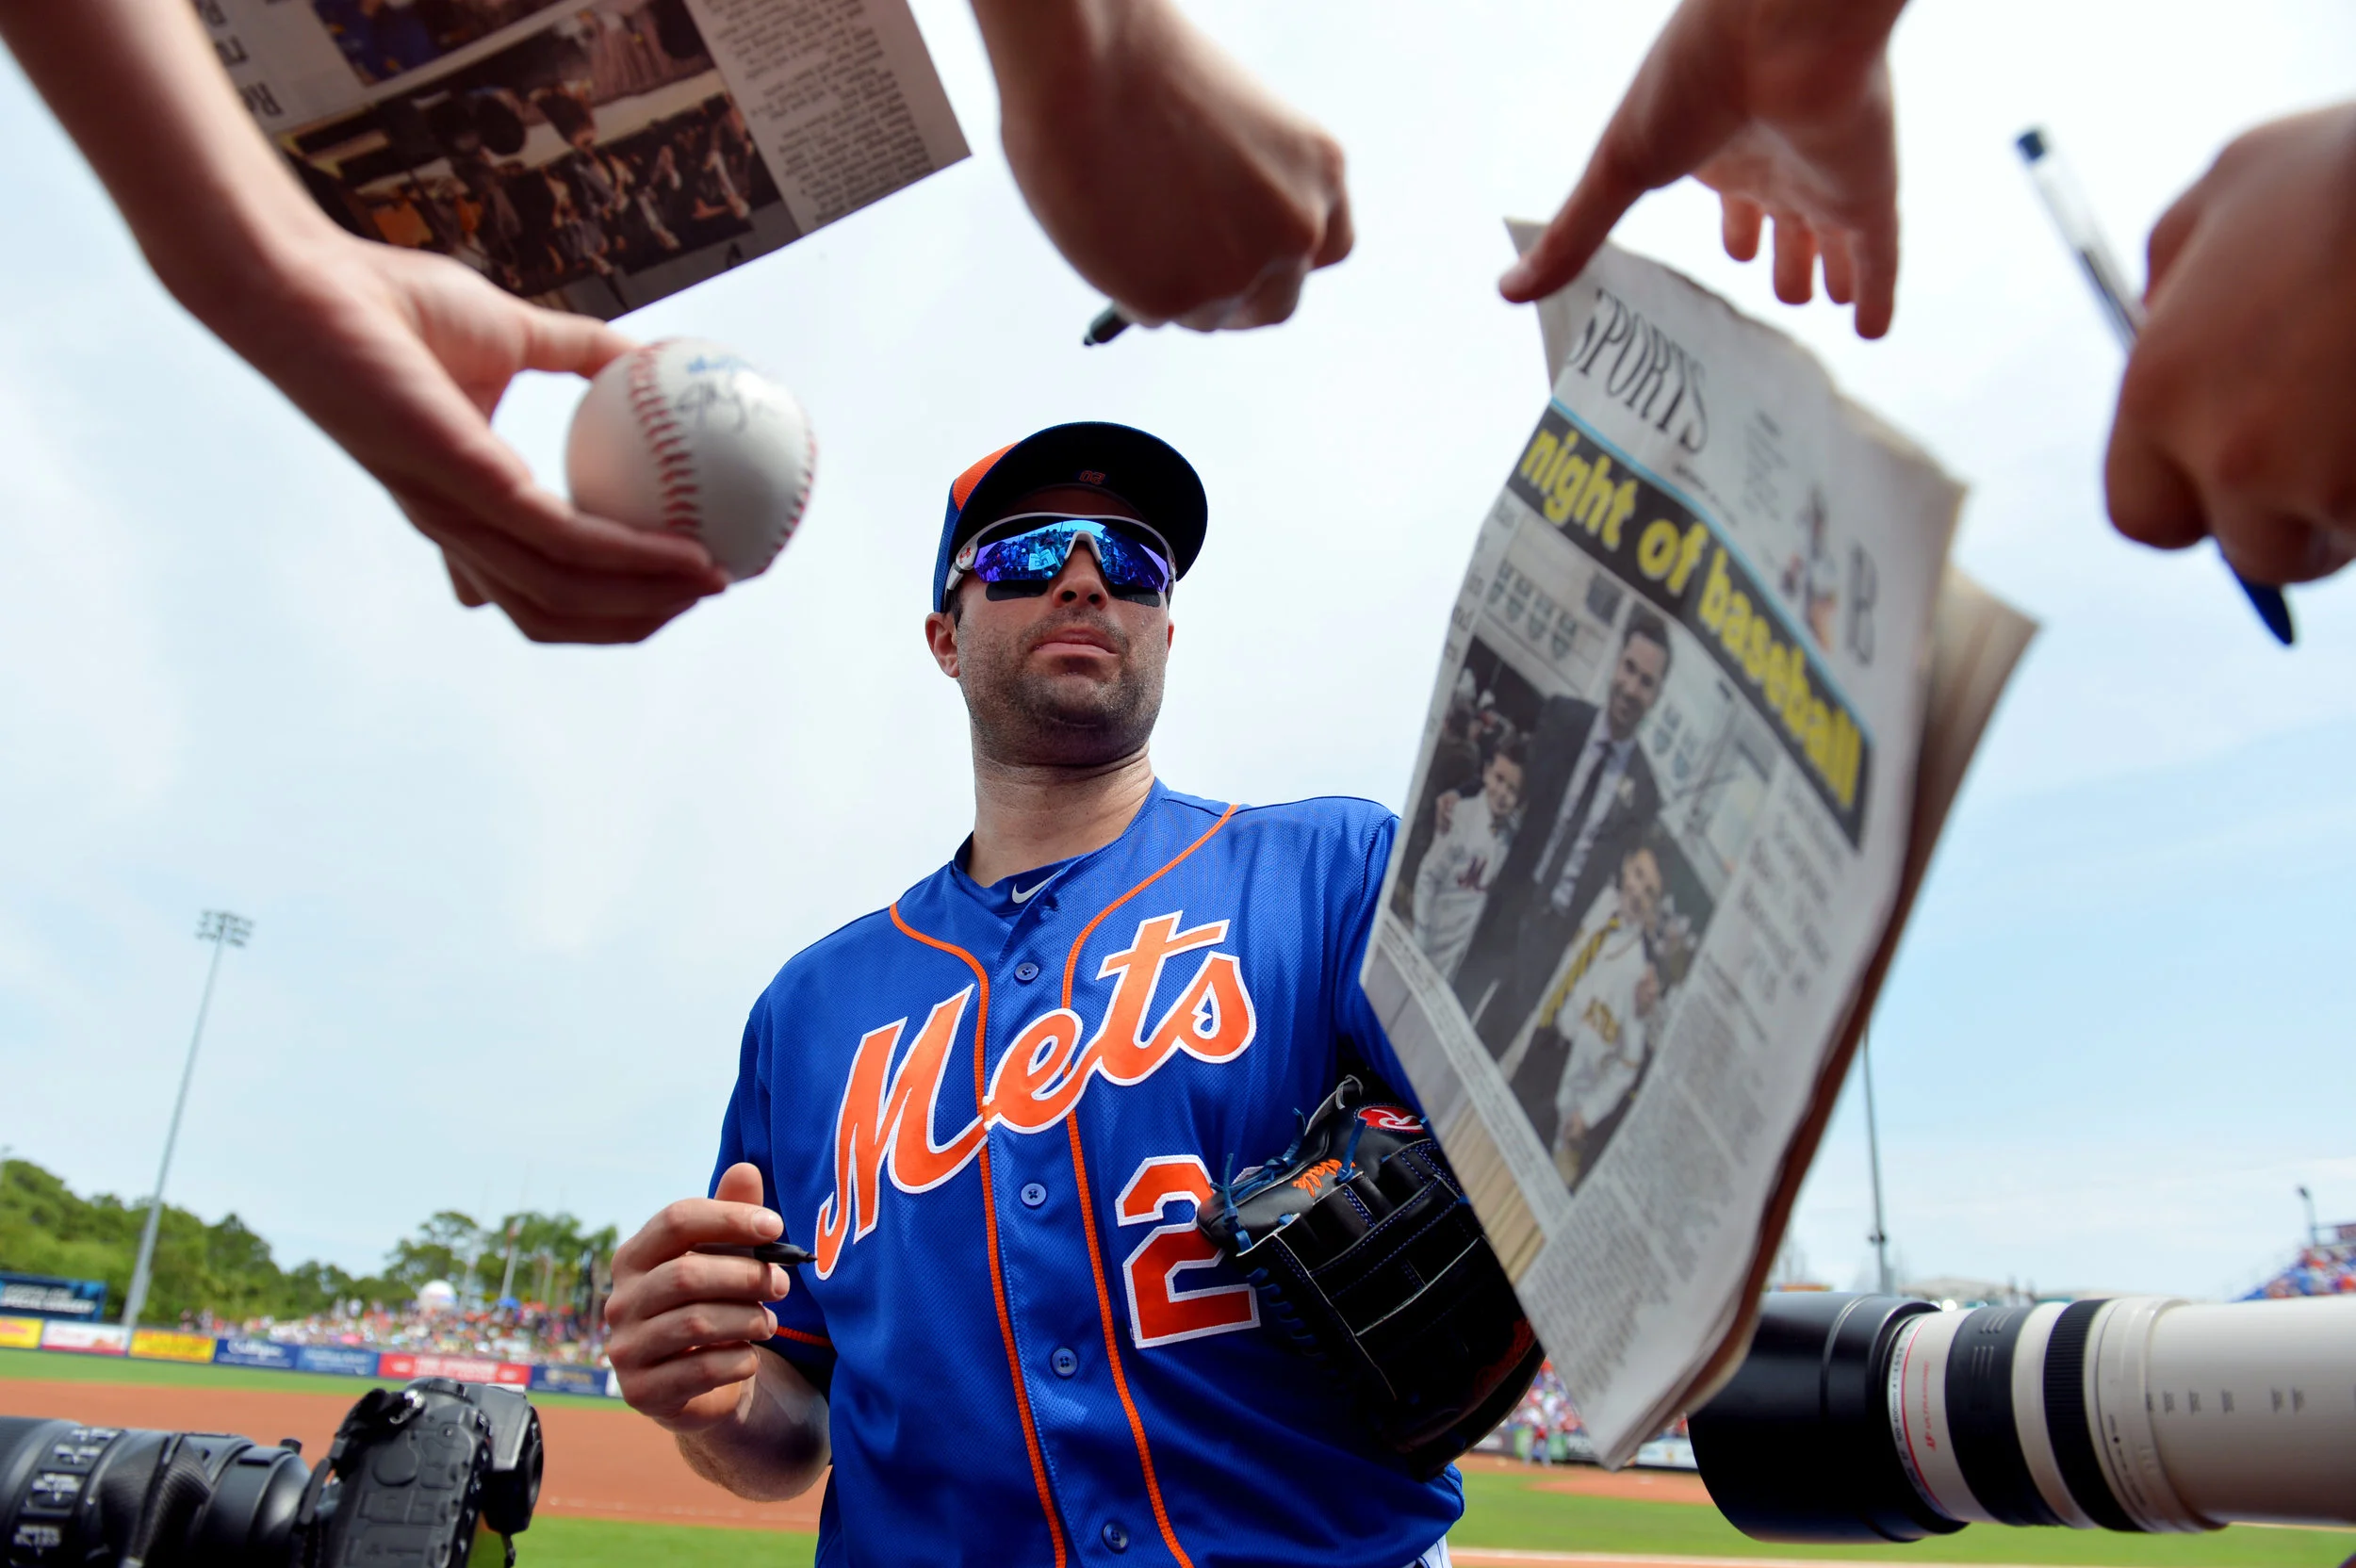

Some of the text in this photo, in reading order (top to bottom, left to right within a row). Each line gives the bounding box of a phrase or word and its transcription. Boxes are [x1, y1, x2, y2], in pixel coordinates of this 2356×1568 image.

[1520, 429, 1638, 551] night
[1637, 519, 1709, 597] of
[1699, 547, 1862, 811] baseball
[814, 909, 1257, 1281] Mets
